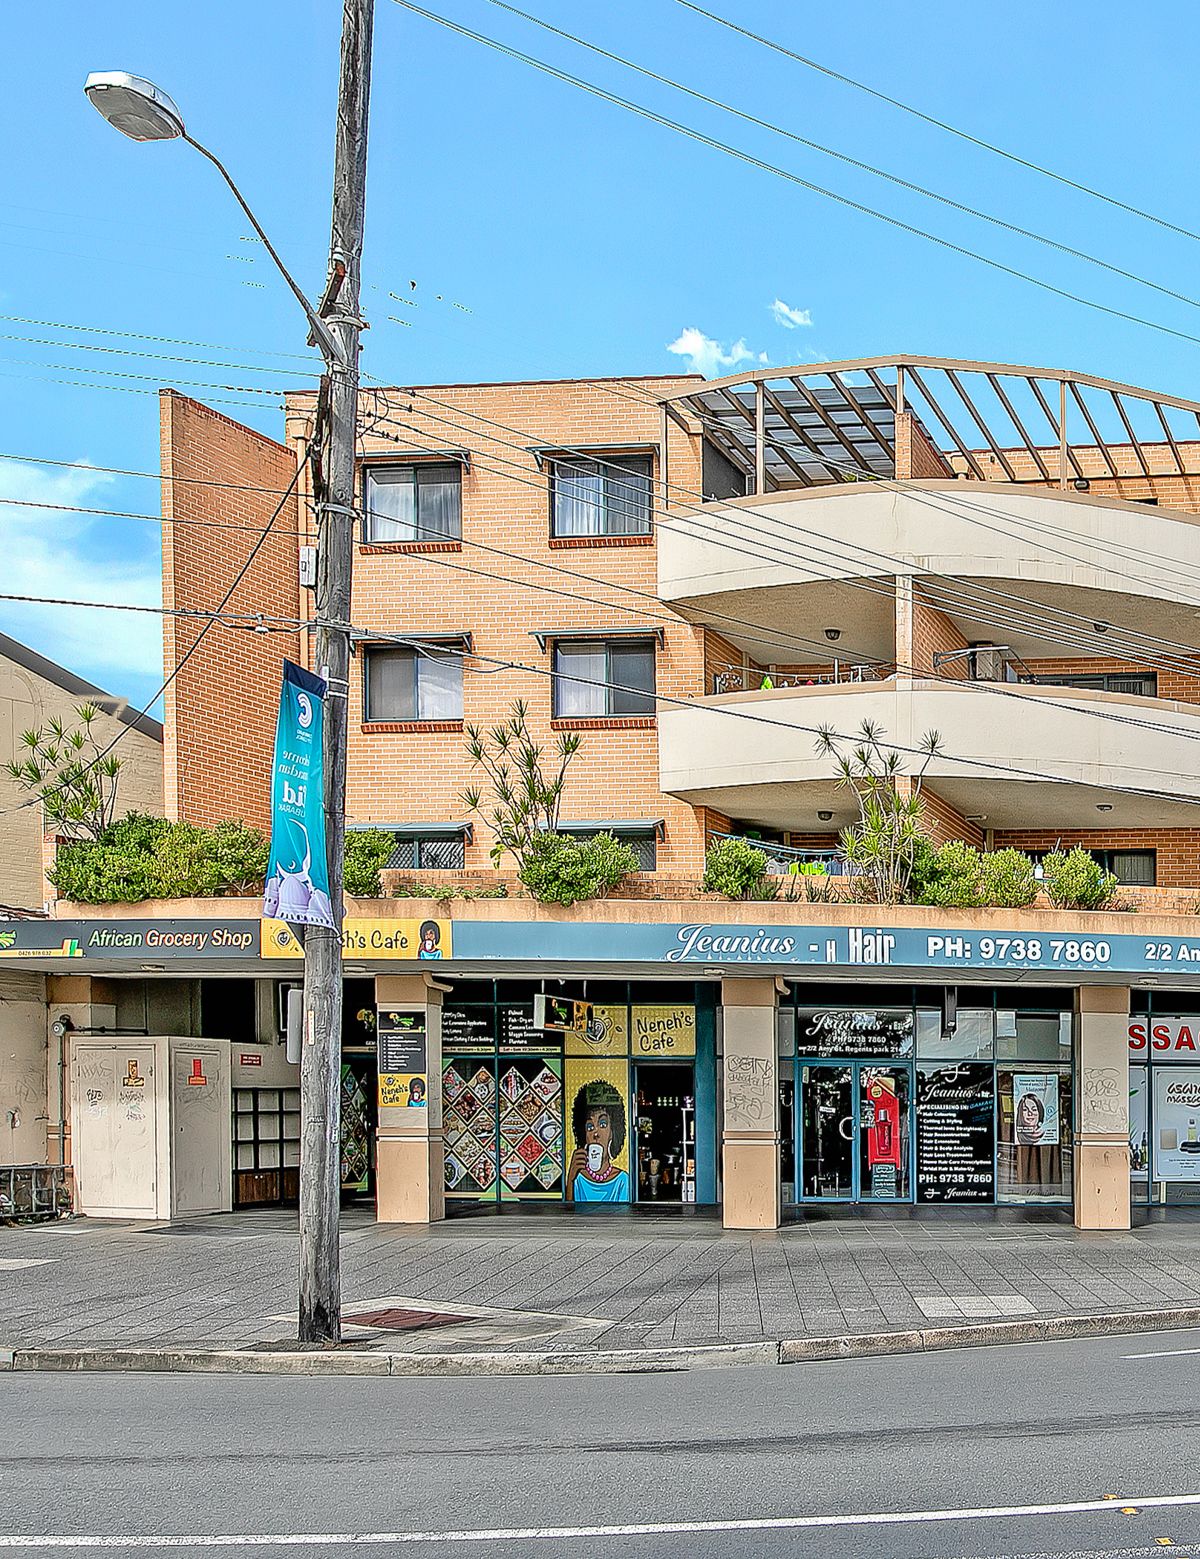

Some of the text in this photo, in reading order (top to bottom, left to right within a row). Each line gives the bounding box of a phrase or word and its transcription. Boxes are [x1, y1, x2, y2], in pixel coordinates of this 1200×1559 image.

[88, 929, 252, 950] African Grocery Shop
[371, 930, 409, 949] Cafe
[666, 924, 797, 962] Jeanius
[848, 927, 896, 963] Hair
[927, 936, 972, 959] PH:
[979, 937, 1042, 961] 9738
[1049, 939, 1111, 963] 7860
[1145, 943, 1172, 960] 2/2
[637, 1011, 694, 1035] Neneh's
[640, 1032, 674, 1051] Cafe
[381, 1084, 408, 1095] Neneh's
[920, 1084, 973, 1101] Jeanius
[383, 1095, 400, 1104] Cafe
[919, 1174, 992, 1183] PH: 9738 7860
